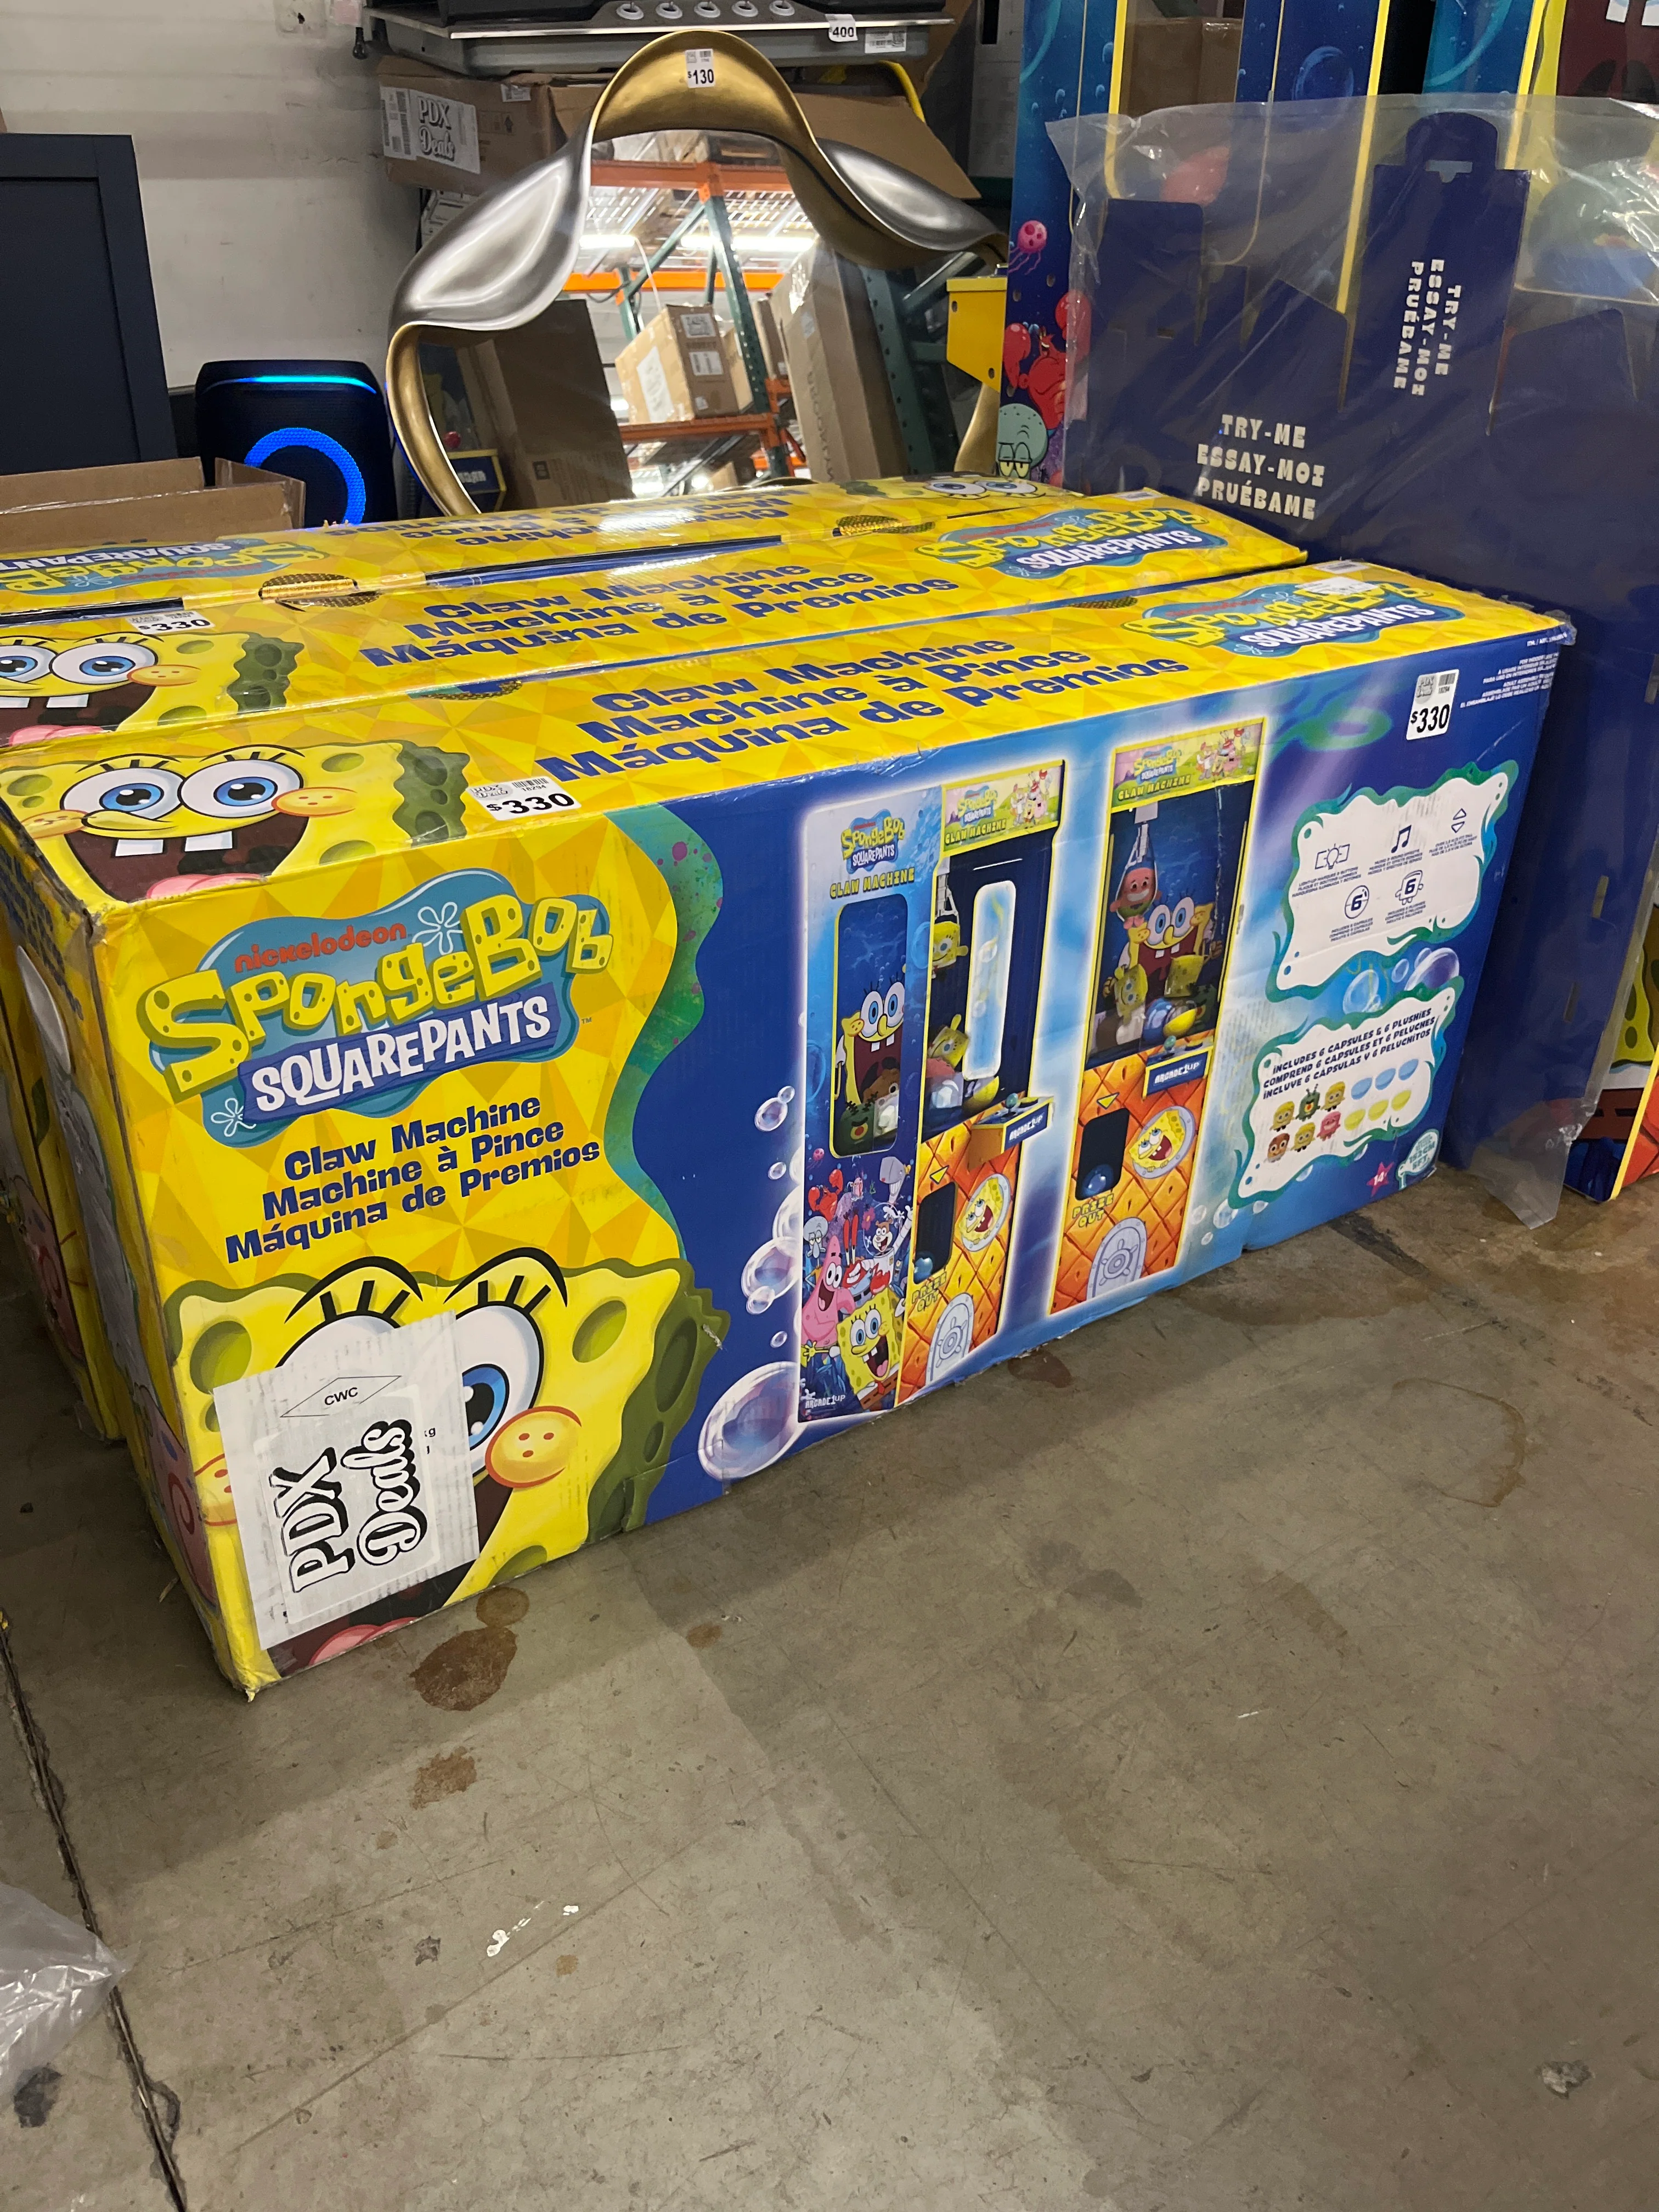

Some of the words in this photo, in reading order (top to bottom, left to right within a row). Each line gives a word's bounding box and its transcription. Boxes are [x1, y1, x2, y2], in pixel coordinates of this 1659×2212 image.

[687, 69, 714, 84] $130
[417, 95, 452, 130] PDX
[419, 125, 455, 162] Deals
[1393, 261, 1425, 389] PRUÉBAME
[1412, 259, 1445, 396] ESSAY-MOI
[1435, 285, 1462, 375] TRY-ME
[1221, 414, 1306, 449] TRY-ME
[1197, 443, 1325, 488] ESSAY-MOI
[1195, 476, 1316, 521] PRUÉBAME
[915, 508, 1210, 568] SpongeBob
[1016, 529, 1203, 570] SQUAREPANTS
[403, 601, 664, 640] Machine
[675, 592, 721, 607] à
[723, 572, 874, 600] Pince
[423, 595, 572, 619] Claw
[581, 565, 811, 601] Machine
[138, 619, 211, 631] $330
[359, 622, 639, 668] Máquina
[651, 612, 729, 629] de
[731, 578, 960, 618] Premios
[1239, 603, 1436, 647] SQUAREPANTS
[577, 686, 868, 744] Machine
[871, 675, 929, 692] à
[924, 651, 1092, 684] Pince
[591, 678, 759, 713] Claw
[763, 640, 1016, 685] Machine
[534, 716, 851, 783] Máquina
[858, 700, 945, 724] de
[940, 659, 1190, 708] Premios
[1410, 704, 1450, 733] $330
[486, 793, 574, 814] $330
[1118, 786, 1144, 802] CLAW
[1147, 774, 1192, 793] MACHINE
[840, 816, 905, 860] SpongeBob
[945, 829, 967, 845] CLAW
[969, 819, 1007, 838] MACHINE
[852, 844, 895, 867] SQUAREPANTS
[830, 878, 860, 899] CLAW
[863, 867, 915, 893] MACHINE
[1351, 894, 1363, 911] 6
[1404, 878, 1417, 895] 6
[235, 919, 407, 973] nickelodeon
[139, 894, 613, 1098] SpongeBob
[251, 995, 551, 1113] SQUAREPANTS
[1263, 1064, 1313, 1088] COMPREND
[1316, 1059, 1322, 1068] 6
[1324, 1041, 1371, 1065] CAPSULES
[1372, 1036, 1384, 1047] ET
[1385, 1034, 1391, 1042] 6
[1393, 1017, 1435, 1040] PELUCHES
[1305, 1074, 1311, 1083] 6
[1372, 1049, 1378, 1058] 6
[1380, 1028, 1431, 1055] PELUCHITOS
[1319, 1048, 1325, 1057] 6
[1328, 1030, 1374, 1053] CAPSULES
[1384, 1024, 1390, 1032] 6
[284, 1138, 376, 1181] Claw
[392, 1096, 540, 1154] Machine
[263, 1158, 422, 1221] Machine
[437, 1146, 458, 1173] à
[472, 1120, 564, 1164] Pince
[225, 1201, 388, 1263] Máquina
[402, 1183, 447, 1213] de
[460, 1142, 600, 1198] Premios
[1072, 1193, 1114, 1219] PRIZE
[1078, 1209, 1104, 1228] OUT
[917, 1289, 939, 1312] OUT
[324, 1387, 358, 1406] CWC
[804, 1394, 846, 1409] ARCADE1UP
[340, 1418, 428, 1567] Deals
[268, 1446, 356, 1593] PDX
